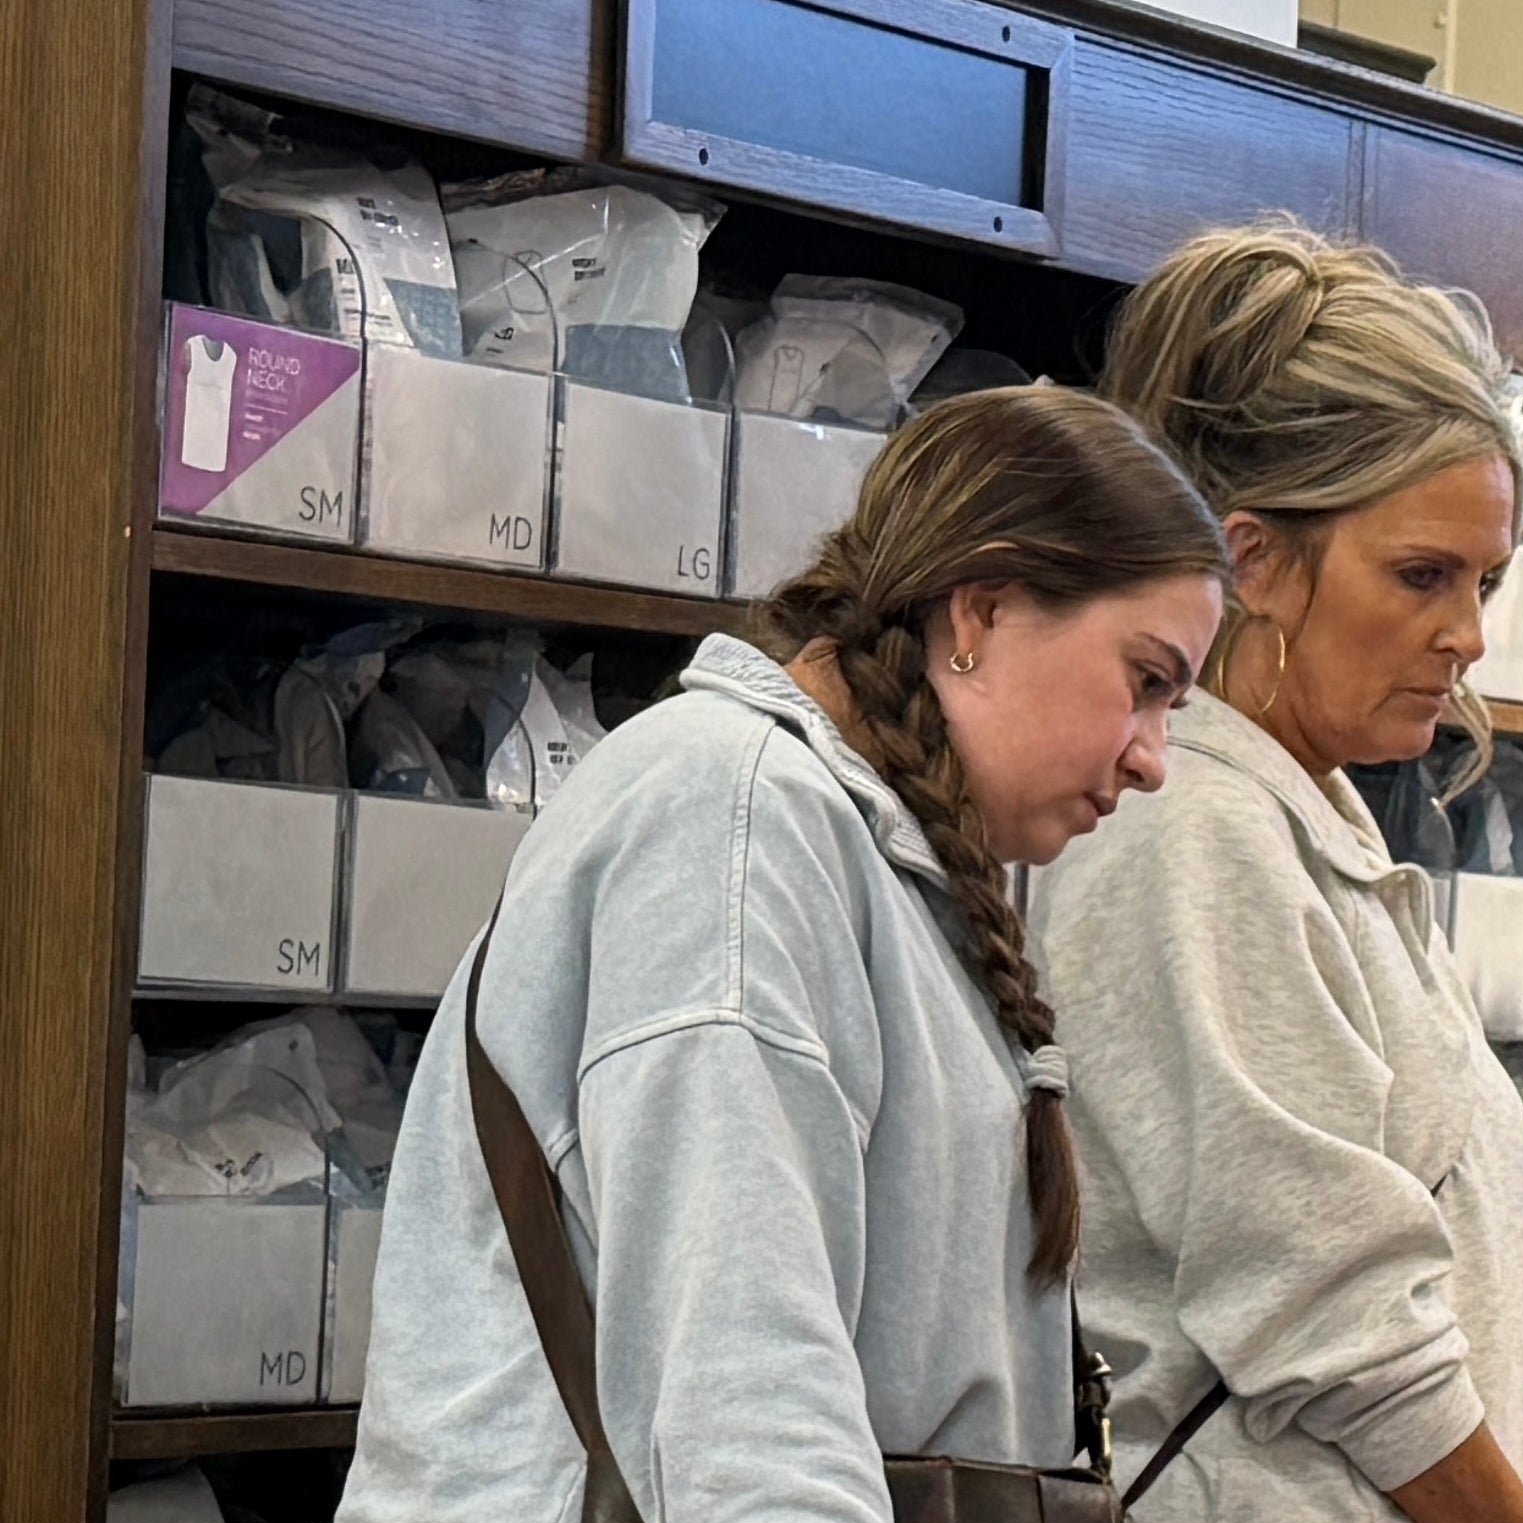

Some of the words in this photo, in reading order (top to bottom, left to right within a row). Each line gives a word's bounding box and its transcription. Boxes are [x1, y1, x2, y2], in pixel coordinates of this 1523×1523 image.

[246, 368, 288, 392] NECK
[248, 346, 301, 376] ROUND
[299, 485, 344, 528] SM
[488, 512, 533, 552] MD
[677, 544, 711, 581] LG
[277, 939, 321, 978] SM
[259, 1350, 307, 1389] MD
